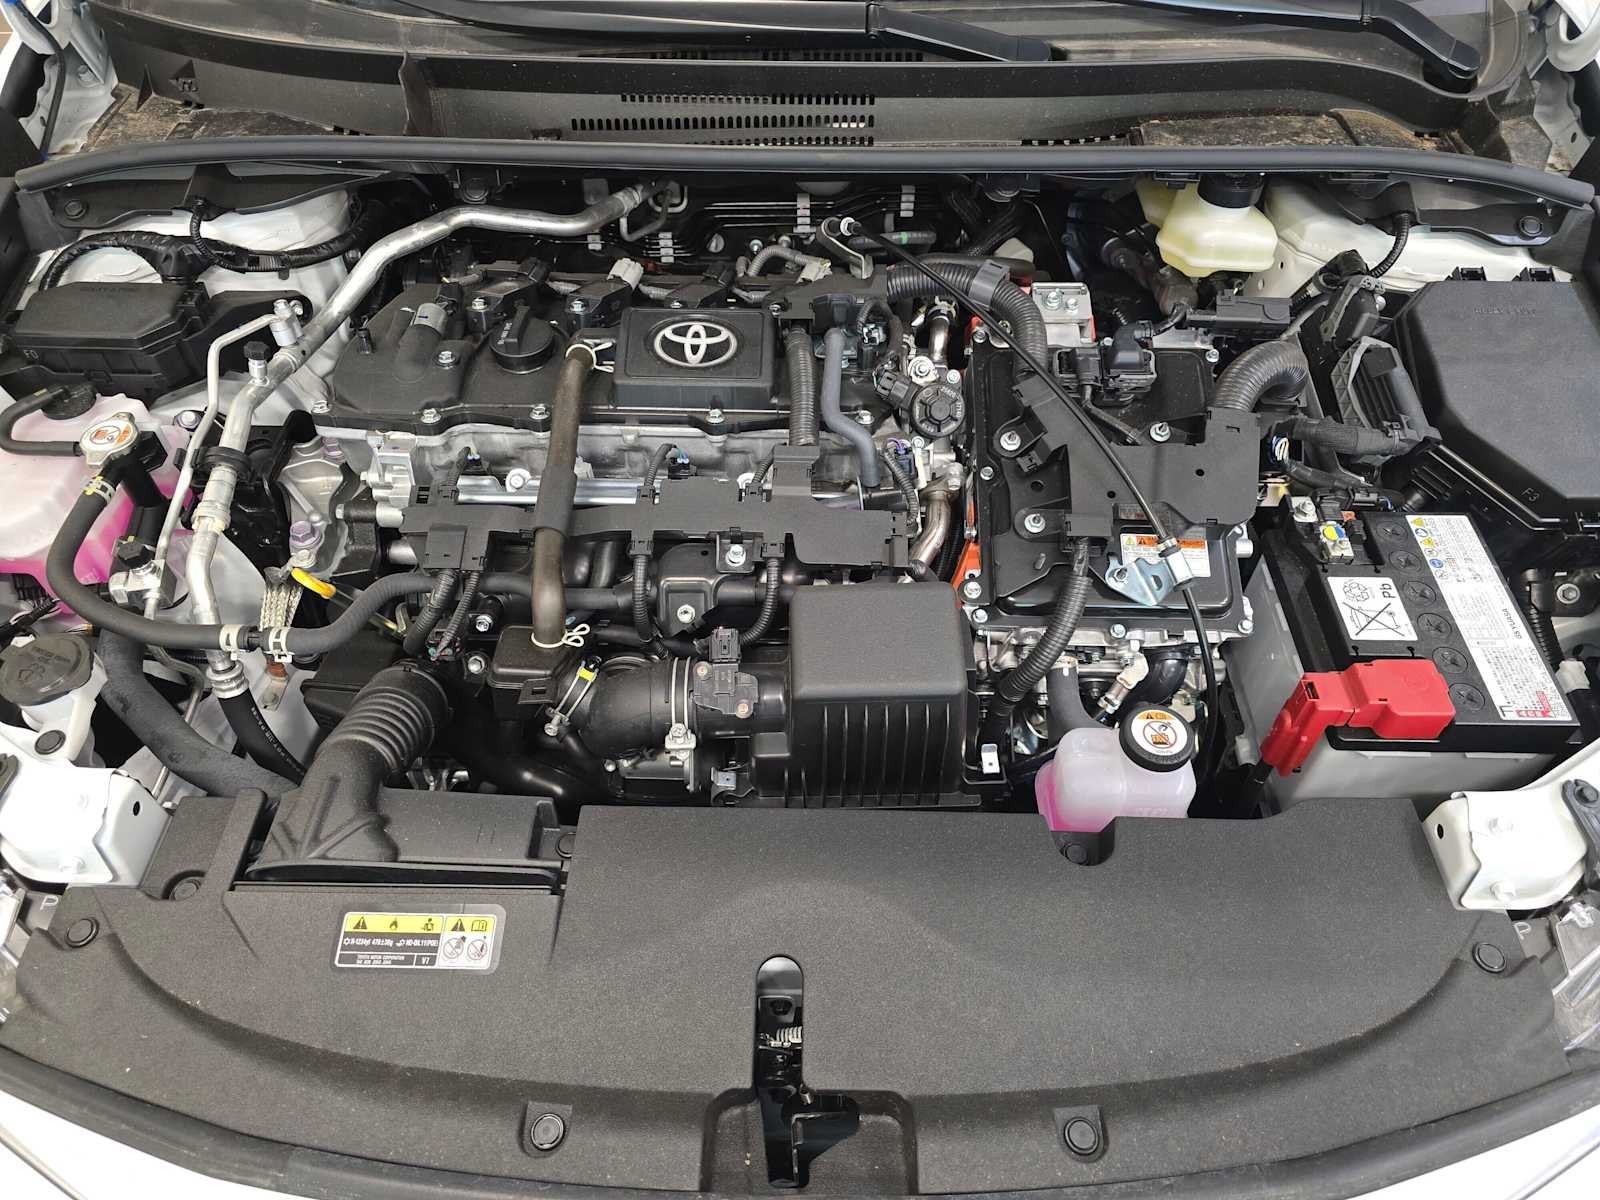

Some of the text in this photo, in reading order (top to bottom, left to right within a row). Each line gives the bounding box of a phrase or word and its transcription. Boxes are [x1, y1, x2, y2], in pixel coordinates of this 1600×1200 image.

[1521, 488, 1540, 501] F3
[1380, 583, 1396, 598] Pb
[421, 956, 430, 965] V7
